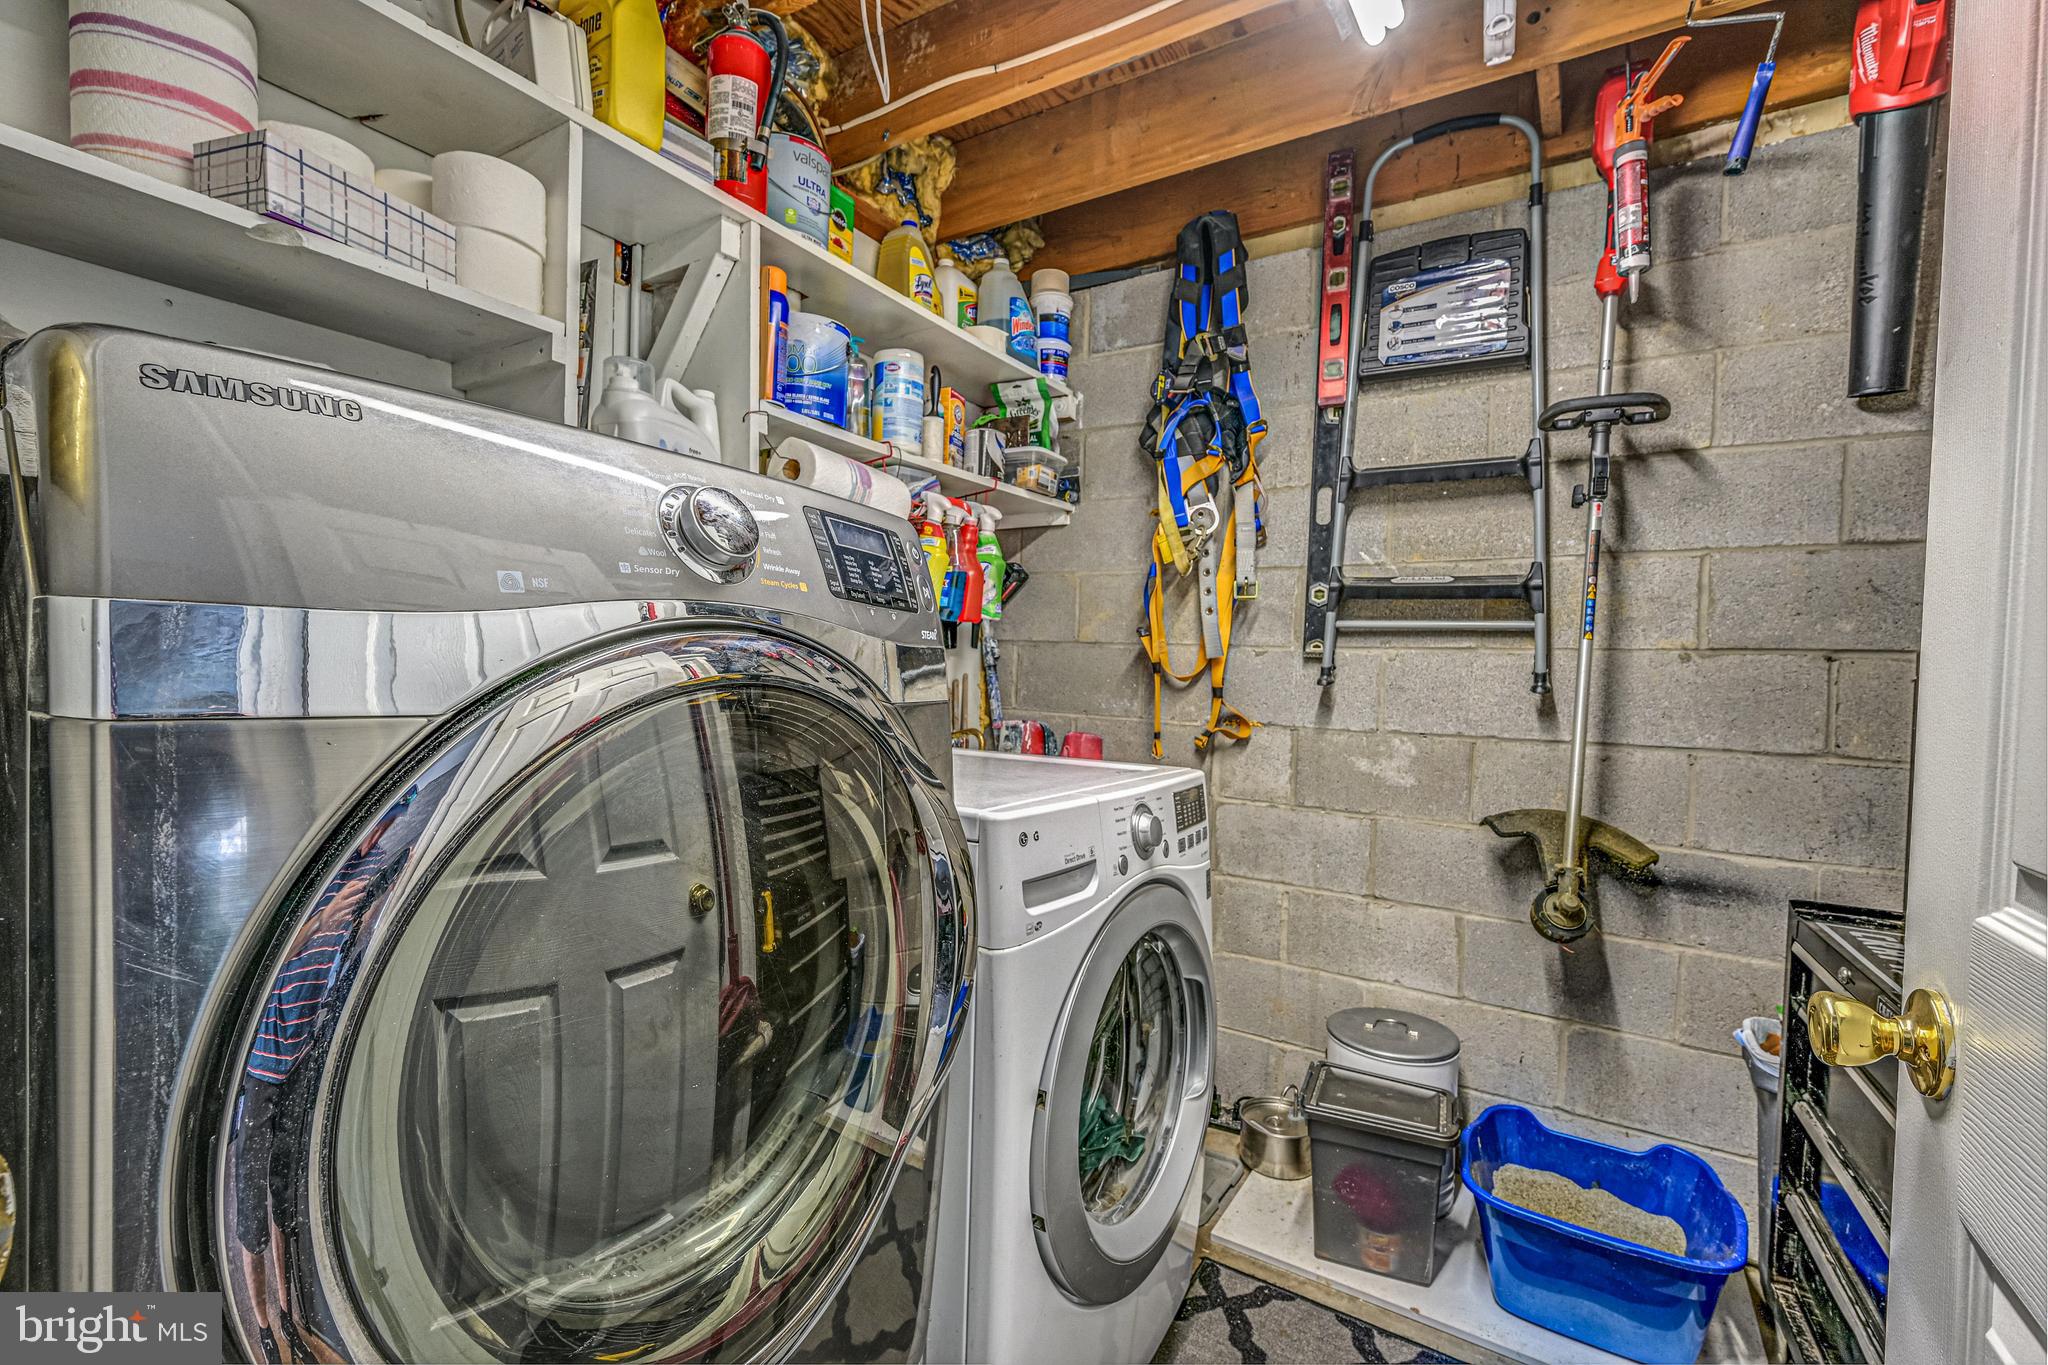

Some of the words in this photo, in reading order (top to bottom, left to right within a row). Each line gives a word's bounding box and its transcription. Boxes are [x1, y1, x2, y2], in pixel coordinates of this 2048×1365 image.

[1859, 22, 1879, 81] Milwaukee
[798, 175, 827, 198] ULTRA
[915, 275, 932, 292] Lysol
[139, 362, 363, 422] SAMSUNG
[739, 488, 764, 500] Manual
[764, 493, 775, 503] Dry
[624, 526, 657, 538] Delicates
[647, 547, 667, 558] Wool
[634, 564, 663, 575] Sensor
[665, 566, 680, 578] Dry
[762, 562, 785, 573] Wrinkle
[785, 567, 801, 577] Away
[531, 577, 550, 588] NSF
[760, 578, 780, 587] Steam
[781, 580, 799, 590] Cycles
